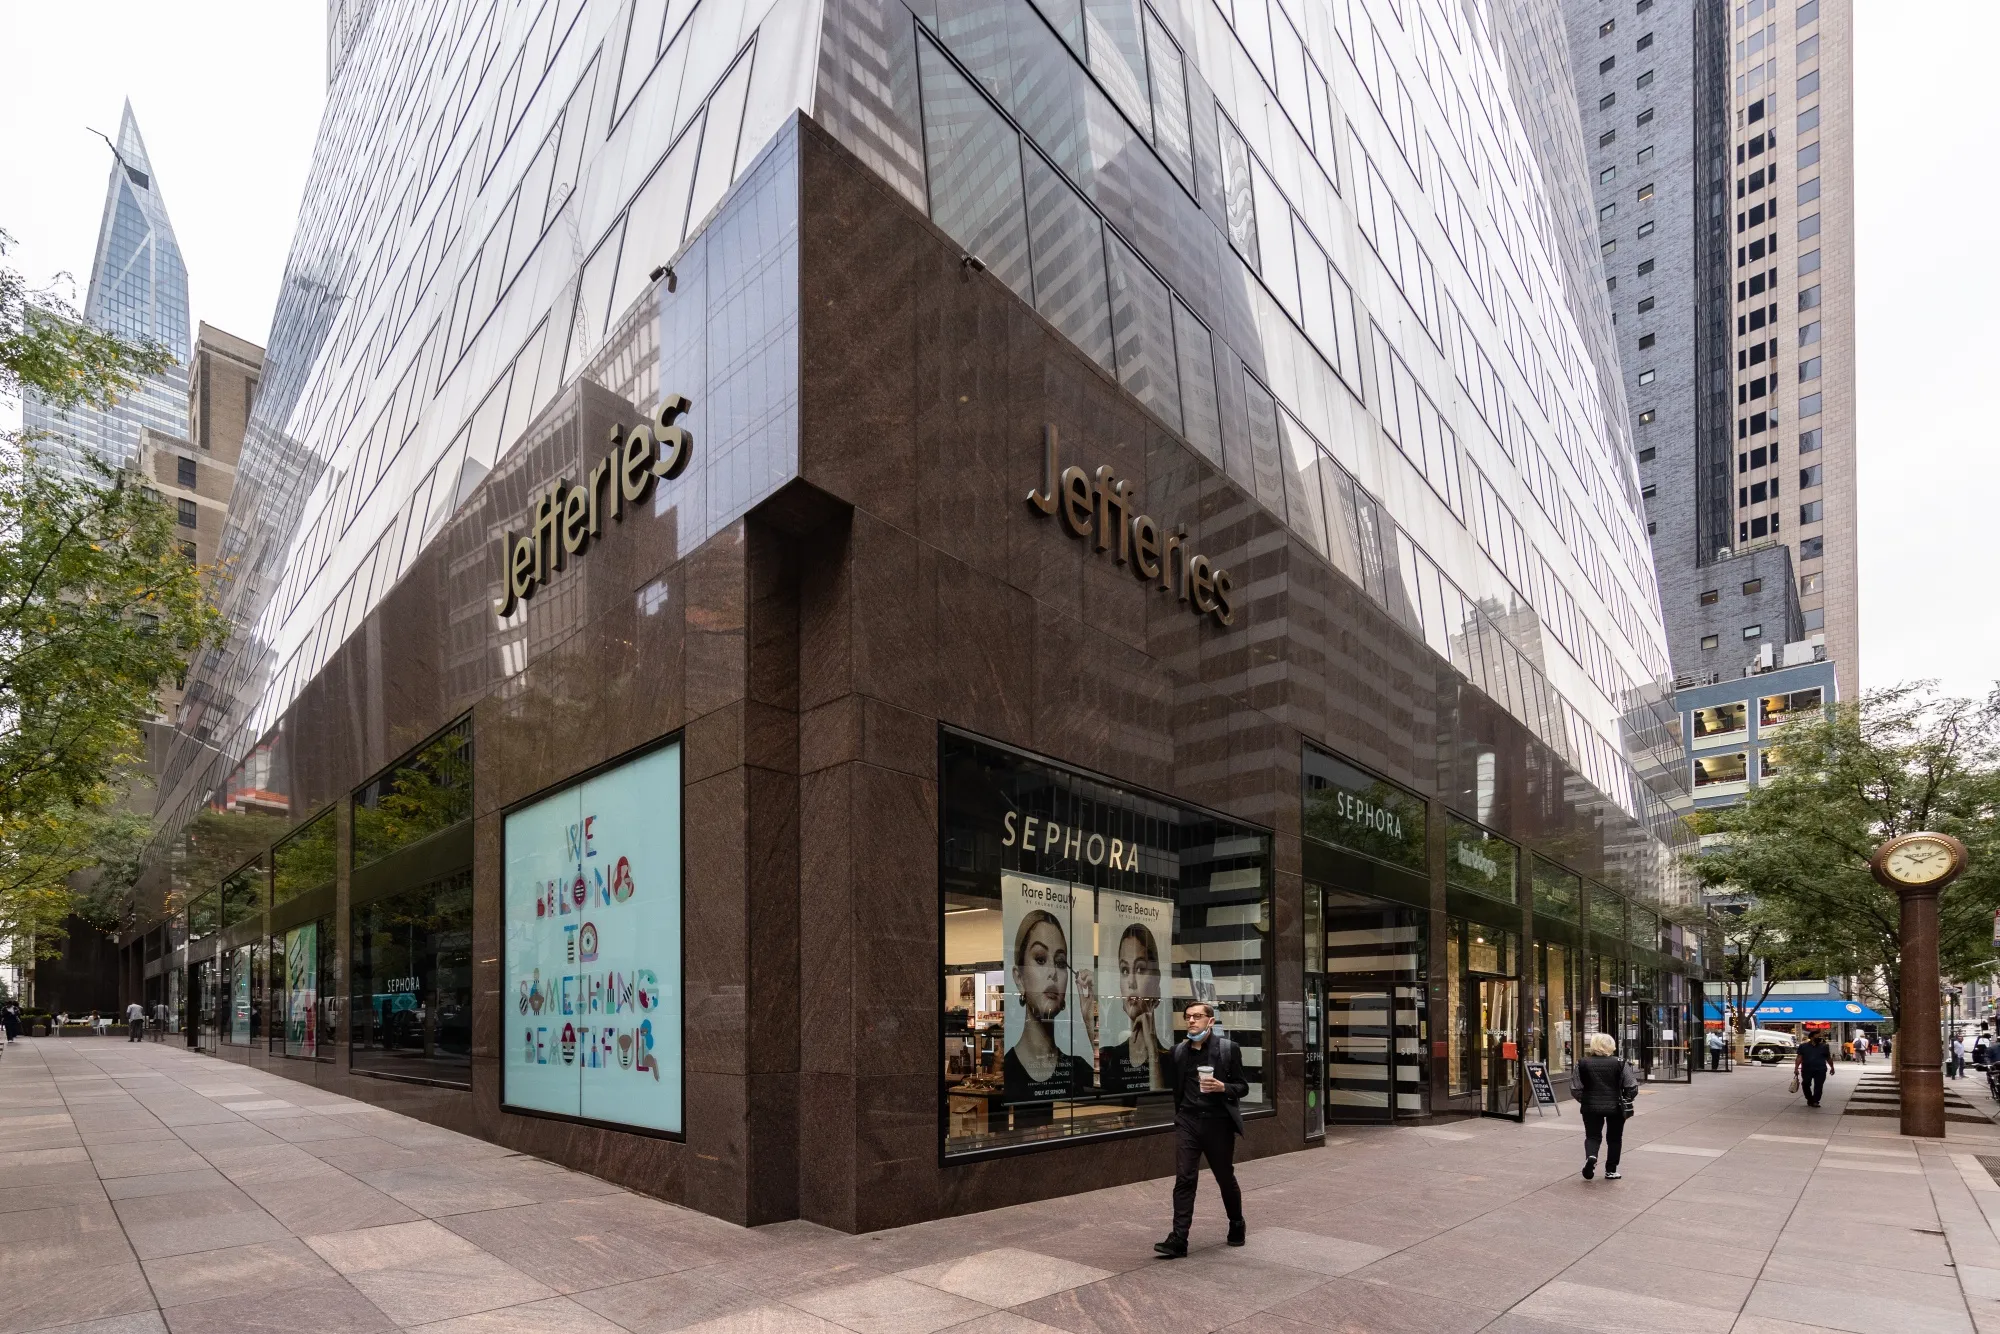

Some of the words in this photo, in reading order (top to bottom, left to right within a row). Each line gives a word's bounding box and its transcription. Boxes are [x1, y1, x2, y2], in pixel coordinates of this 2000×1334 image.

[496, 392, 694, 618] Jefferies
[1026, 423, 1235, 626] Jefferies
[565, 814, 597, 862] WE
[1337, 791, 1402, 839] SEPHORA
[1002, 811, 1139, 873] SEPHORA
[536, 856, 635, 920] BELONG
[1021, 883, 1044, 900] Rare
[1115, 899, 1133, 914] Rare
[1134, 902, 1160, 921] Beauty
[563, 921, 599, 964] TO
[387, 976, 420, 993] SEPHORA
[519, 967, 660, 1016] SOMETHING
[525, 1019, 660, 1082] BEAUTIFUL
